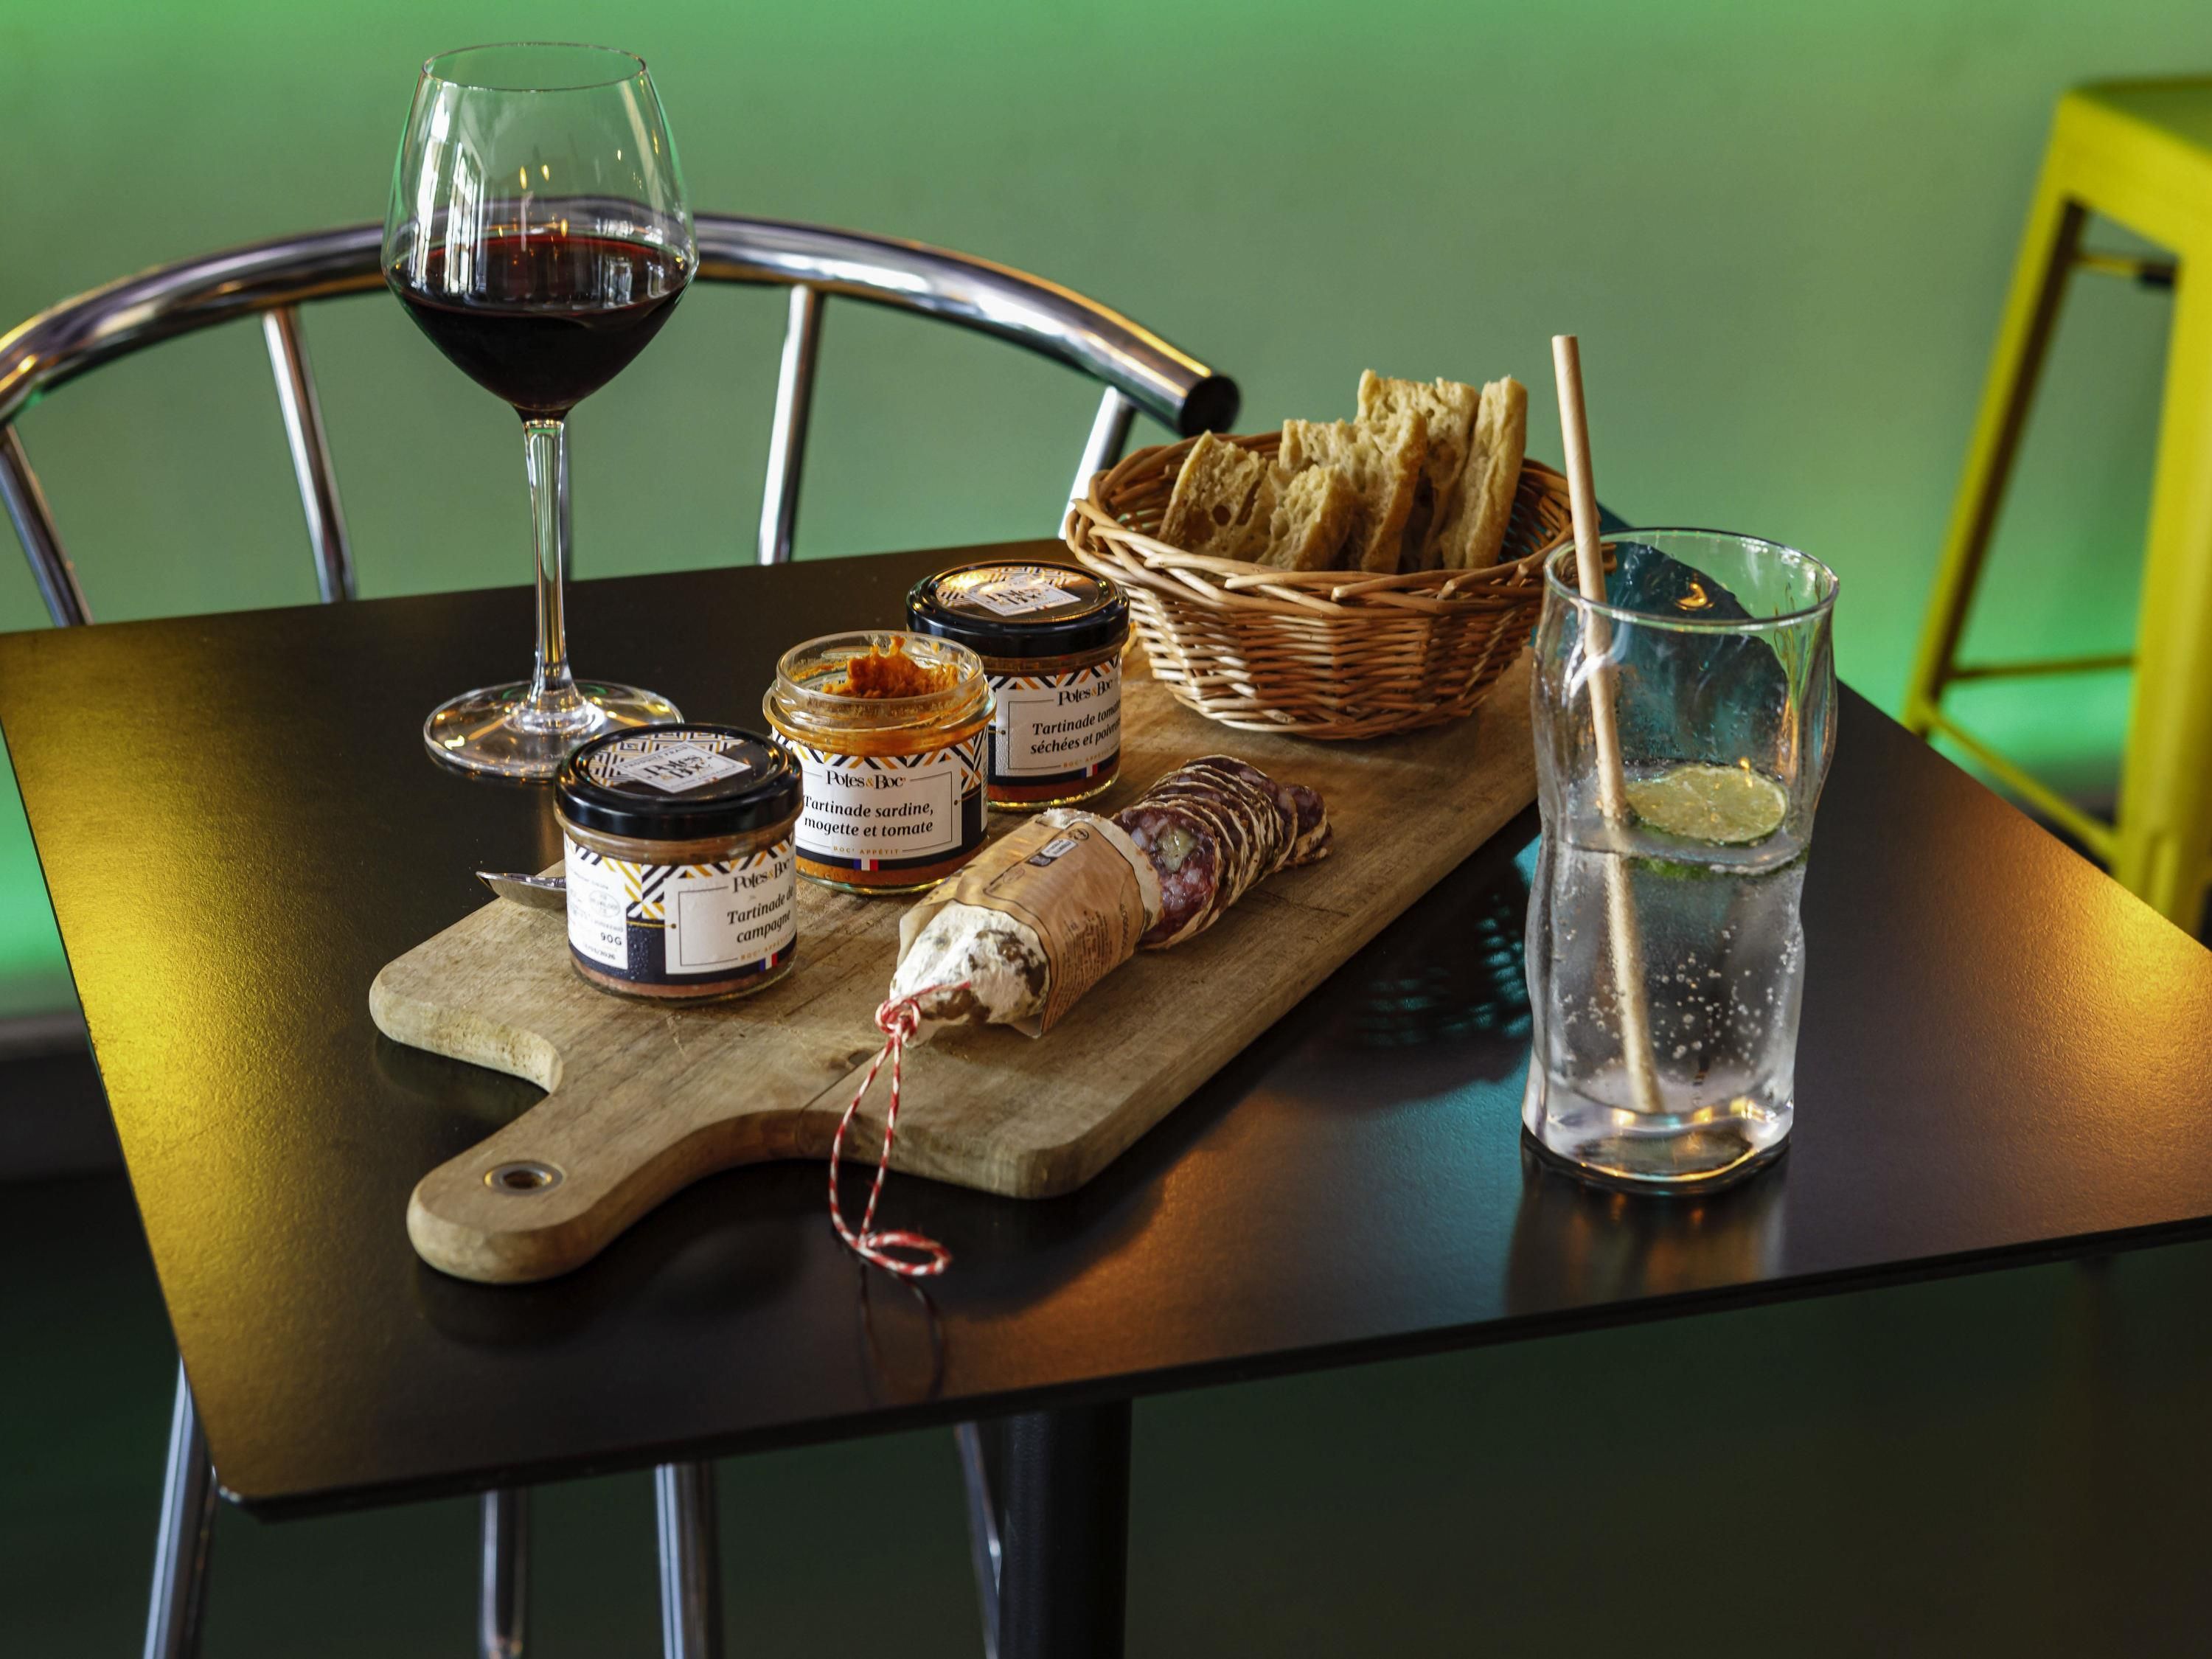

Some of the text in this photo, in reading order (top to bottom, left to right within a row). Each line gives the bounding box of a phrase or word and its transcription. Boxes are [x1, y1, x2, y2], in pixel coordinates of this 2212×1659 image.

[1032, 714, 1096, 735] Tartinade
[1030, 737, 1080, 754] séchées
[1082, 733, 1093, 746] et
[804, 795, 933, 817] Tartinade sardine,
[804, 816, 933, 837] mogette et tomate
[727, 885, 794, 925] Tartinade de
[737, 909, 790, 943] campagne
[600, 932, 622, 946] 90G
